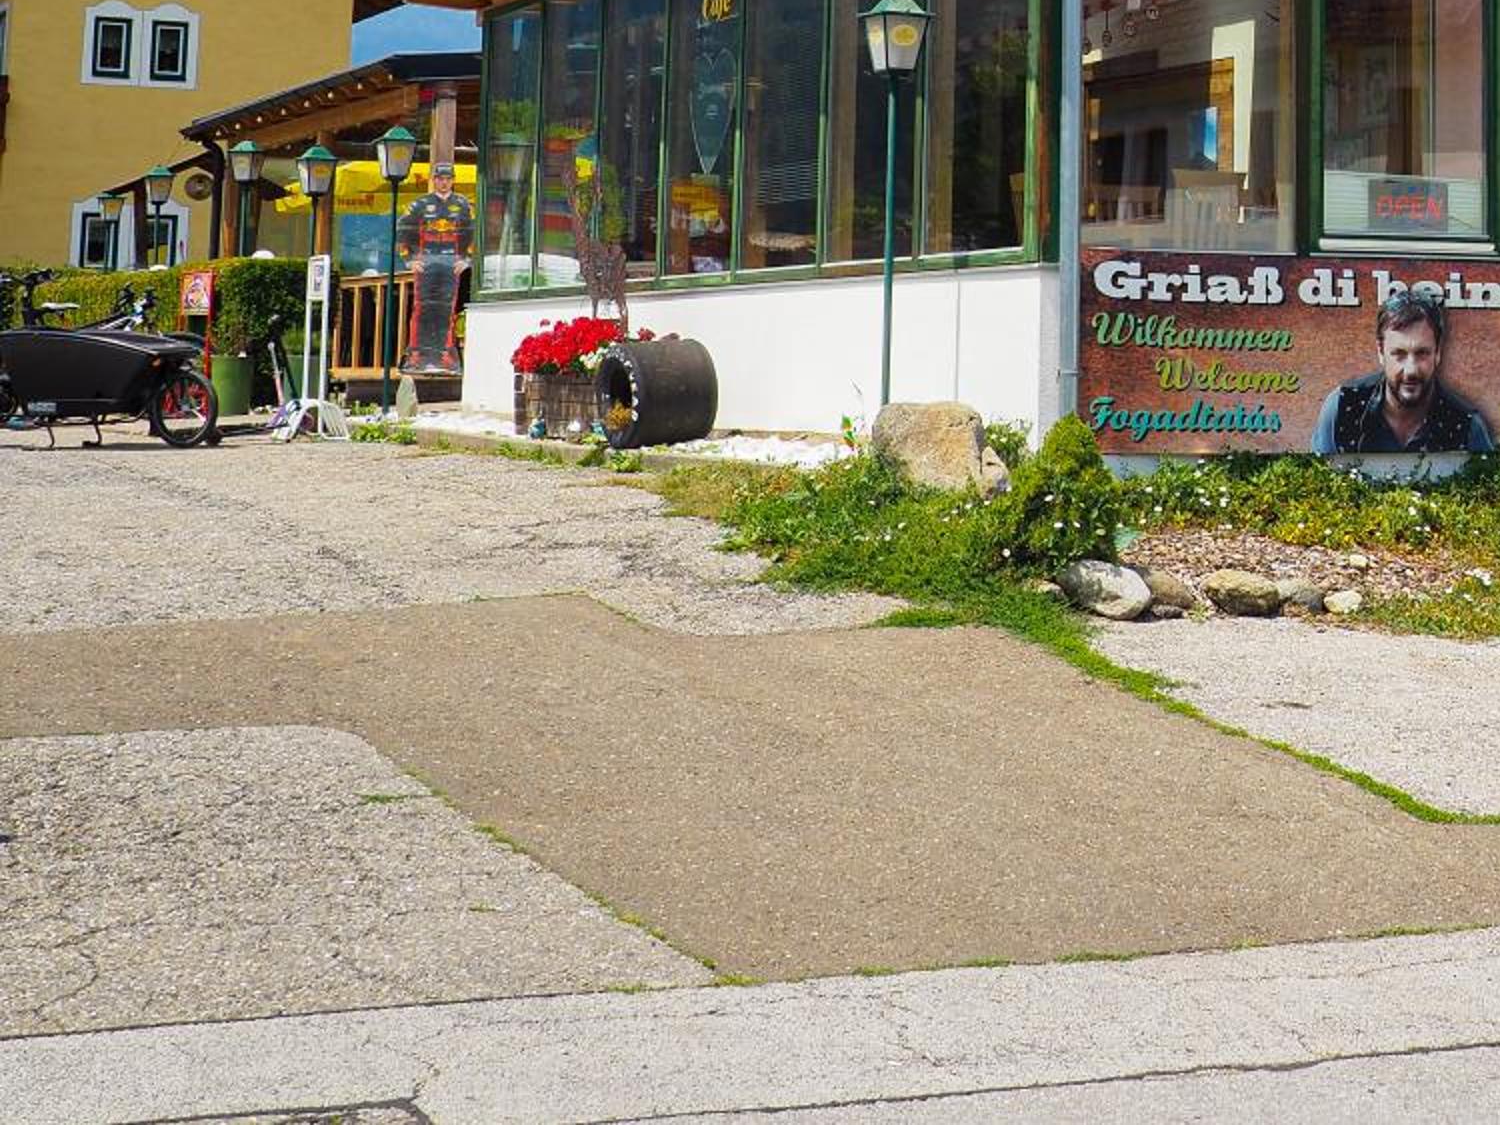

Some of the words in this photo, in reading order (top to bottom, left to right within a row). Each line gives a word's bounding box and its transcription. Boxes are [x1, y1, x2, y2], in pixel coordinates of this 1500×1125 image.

[1375, 194, 1441, 220] OPEN
[1093, 259, 1285, 305] Griaß
[1298, 268, 1360, 307] di
[1091, 311, 1294, 351] Wilkommen
[1156, 356, 1300, 393] Welcome
